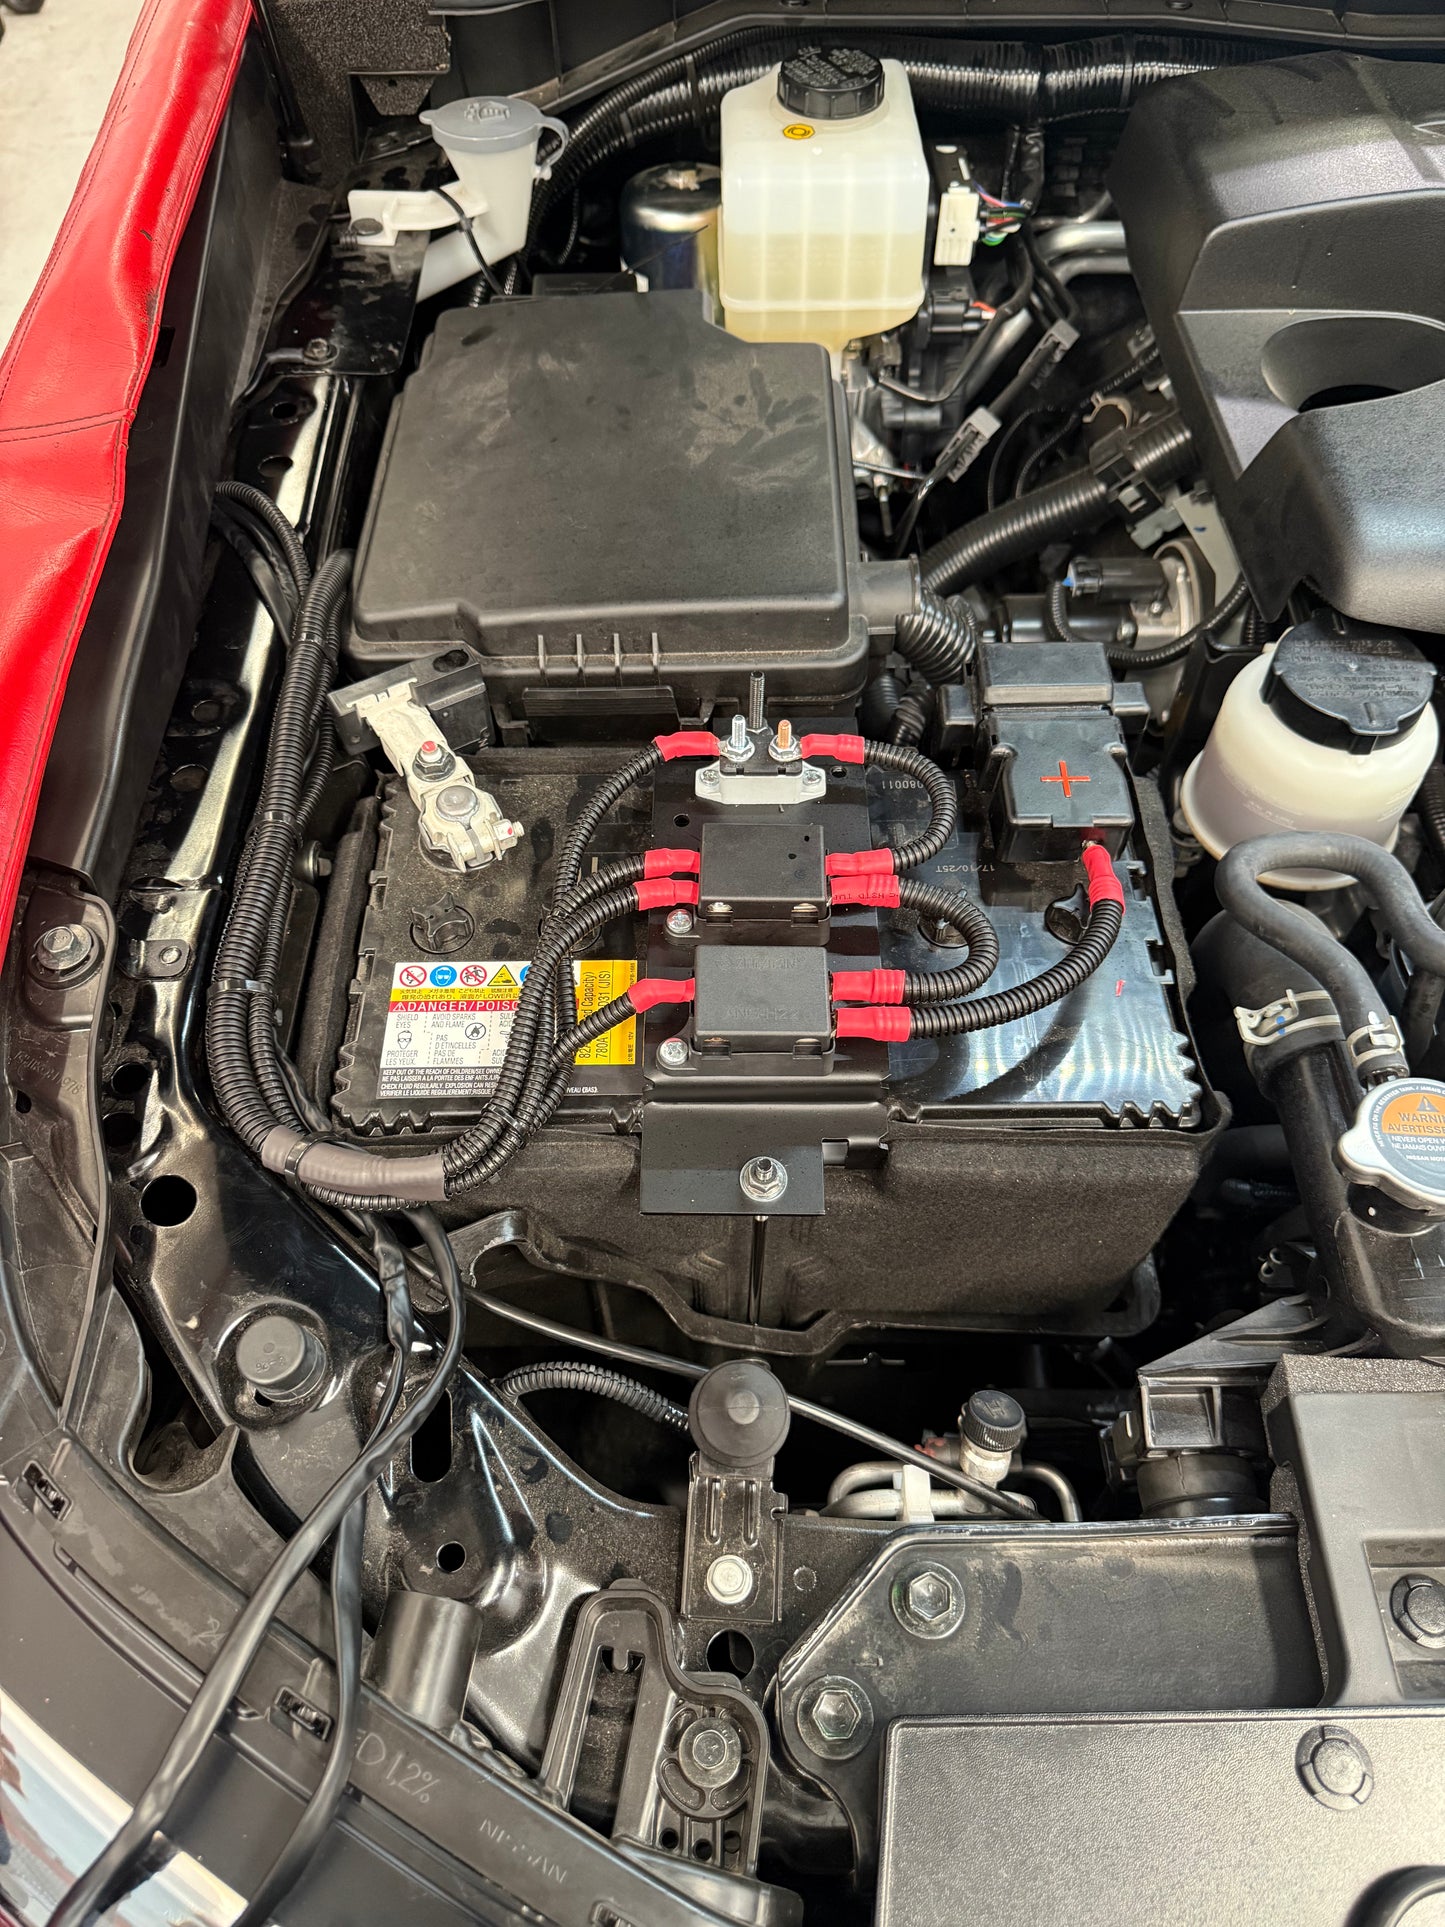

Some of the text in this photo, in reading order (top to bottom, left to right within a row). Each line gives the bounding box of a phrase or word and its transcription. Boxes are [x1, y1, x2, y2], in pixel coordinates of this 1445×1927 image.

[407, 1001, 520, 1012] DANGER/POISO
[396, 1013, 419, 1021] SHIELD
[432, 1012, 476, 1021] AVOID SPARKS
[395, 1021, 411, 1029] EYES
[431, 1020, 465, 1029] AND FLAME
[436, 1034, 448, 1042] PAS
[434, 1049, 456, 1057] PAS DE
[385, 1058, 398, 1066] LES
[432, 1057, 464, 1065] FLAMMES
[1388, 1123, 1445, 1134] AVERTISSE
[1391, 1135, 1417, 1143] NEVER
[1417, 1136, 1440, 1144] OPEN
